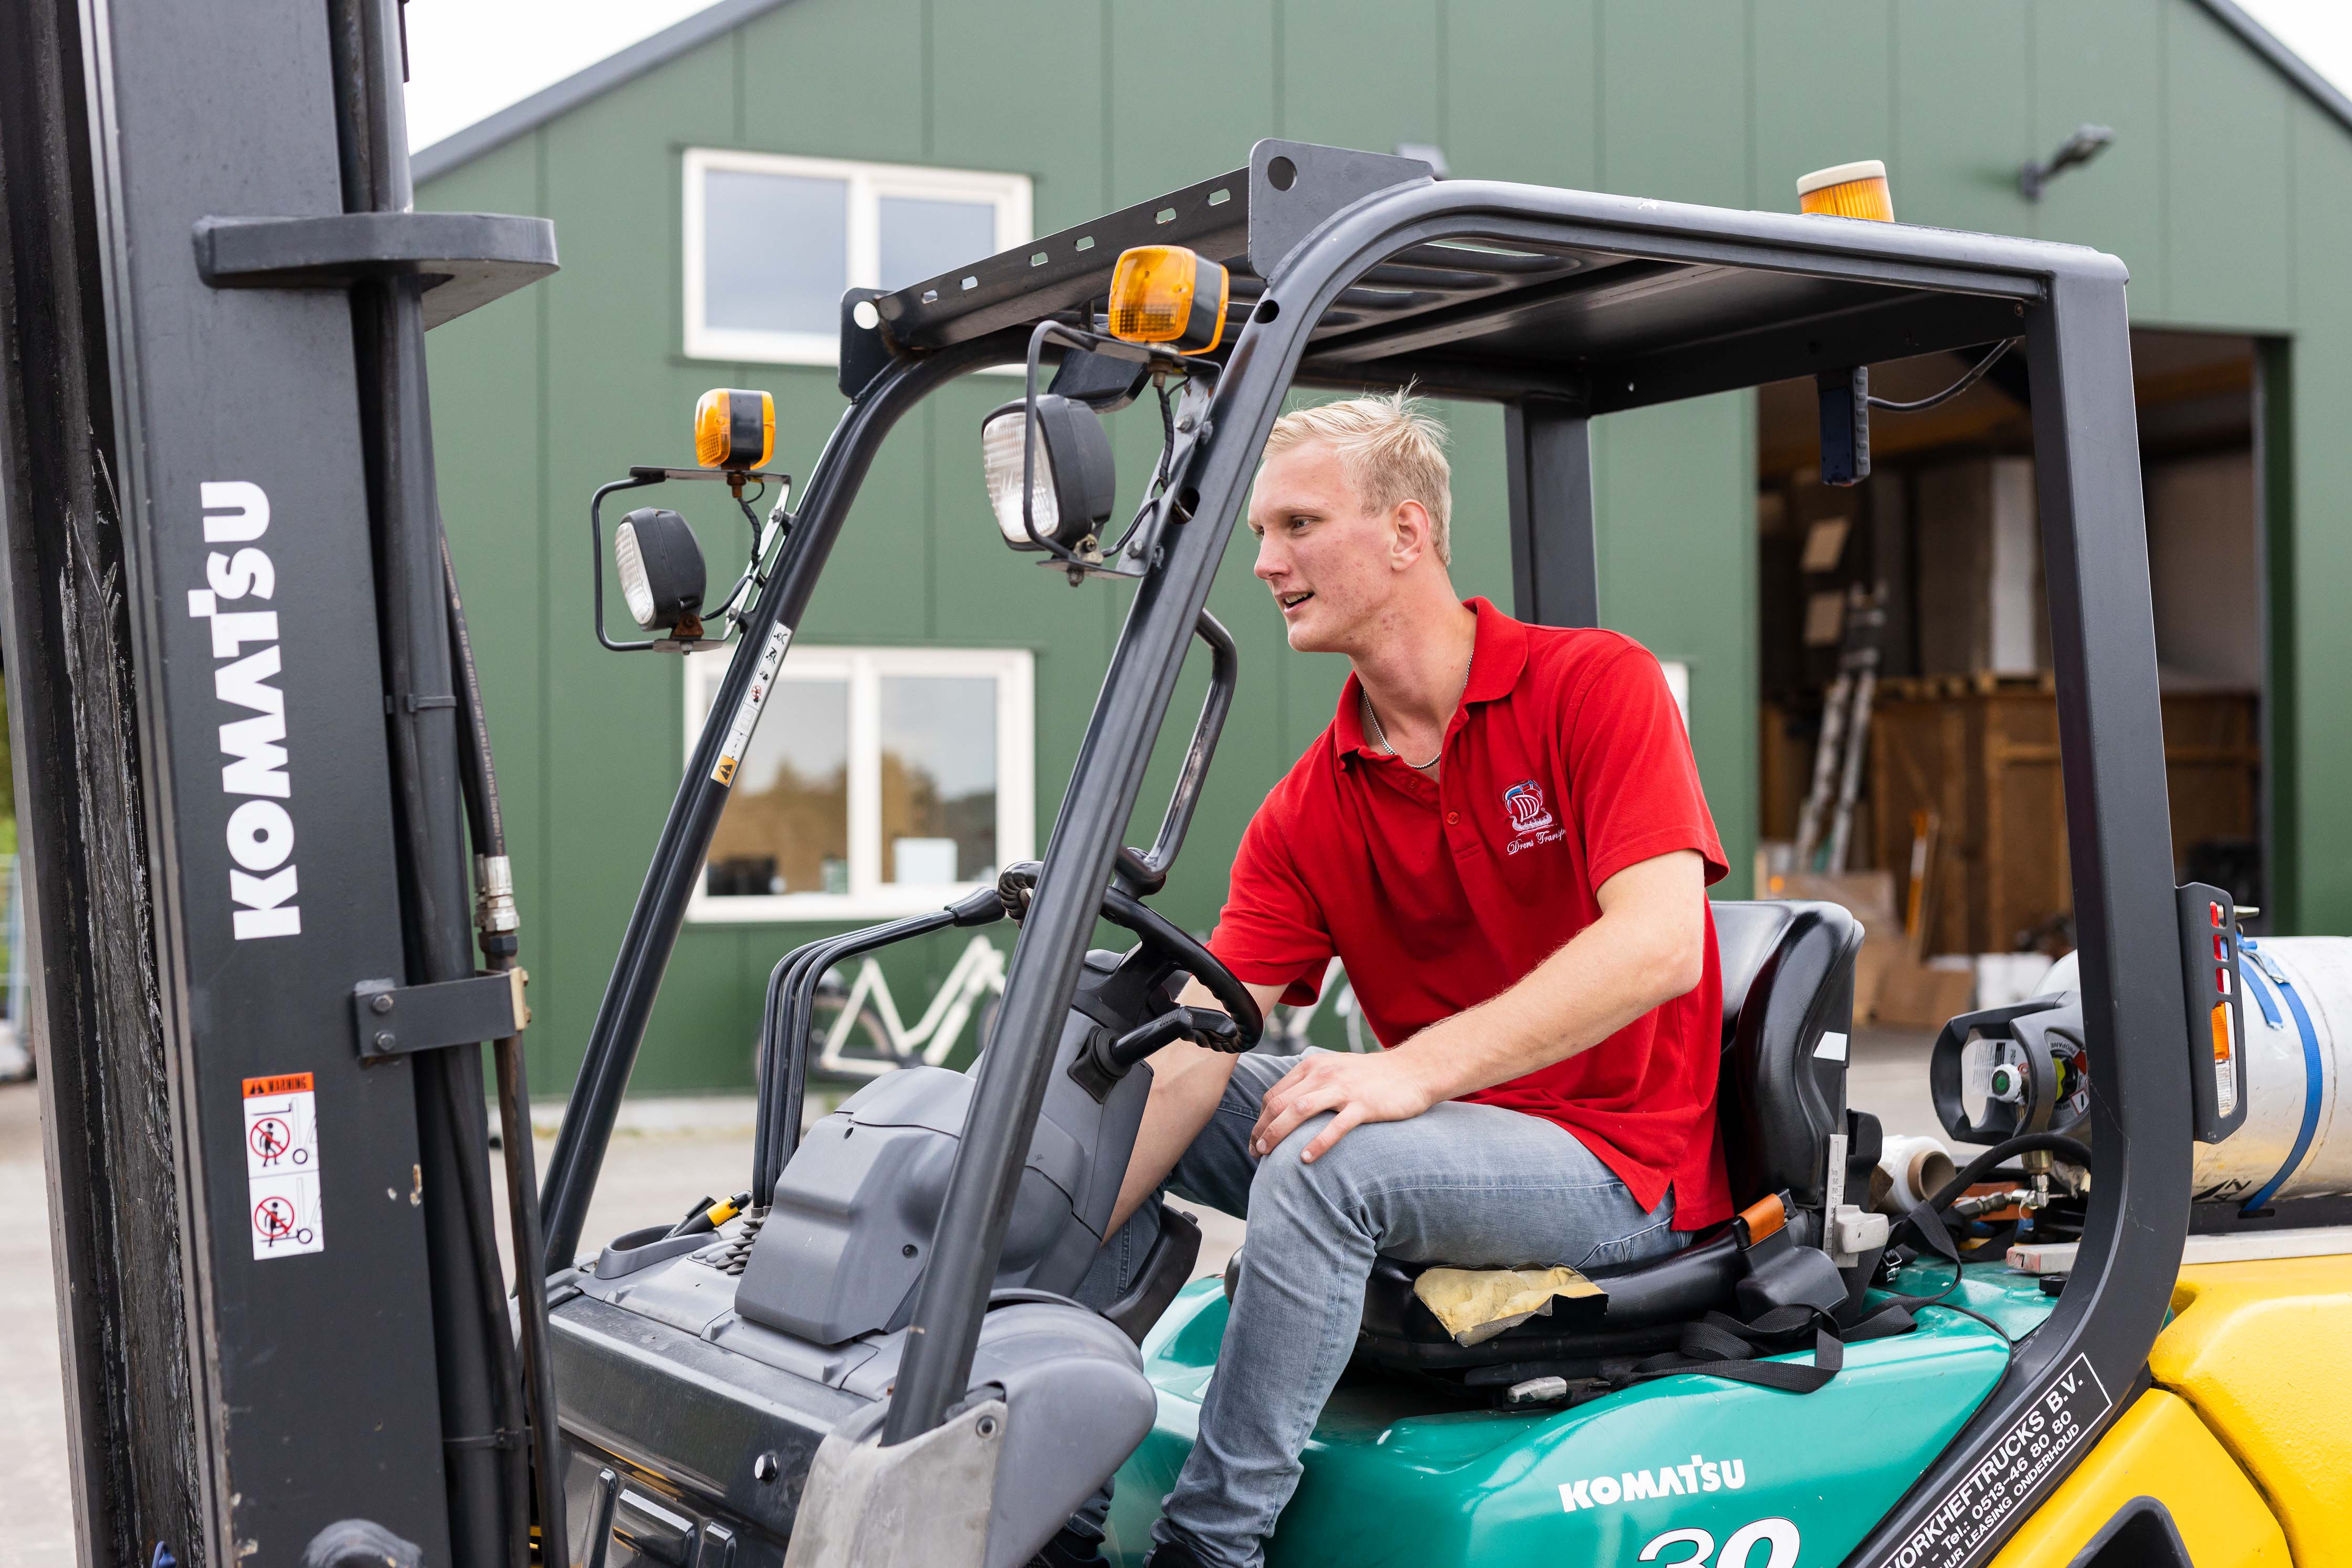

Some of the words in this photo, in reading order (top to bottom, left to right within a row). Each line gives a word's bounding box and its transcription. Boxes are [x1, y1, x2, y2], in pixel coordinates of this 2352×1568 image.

[188, 481, 301, 940] KOMATSU
[268, 1076, 307, 1092] WARNING
[2045, 1372, 2083, 1414] B.V.
[1558, 1455, 1746, 1512] KOMATSU
[1940, 1521, 1970, 1550] Tel.:
[1971, 1457, 2028, 1520] 0513-46
[2030, 1434, 2050, 1458] 80
[2052, 1411, 2072, 1435] 80
[1965, 1496, 2013, 1549] LEASING
[2013, 1424, 2080, 1497] ONDERHOUD
[1637, 1517, 1801, 1568] 30
